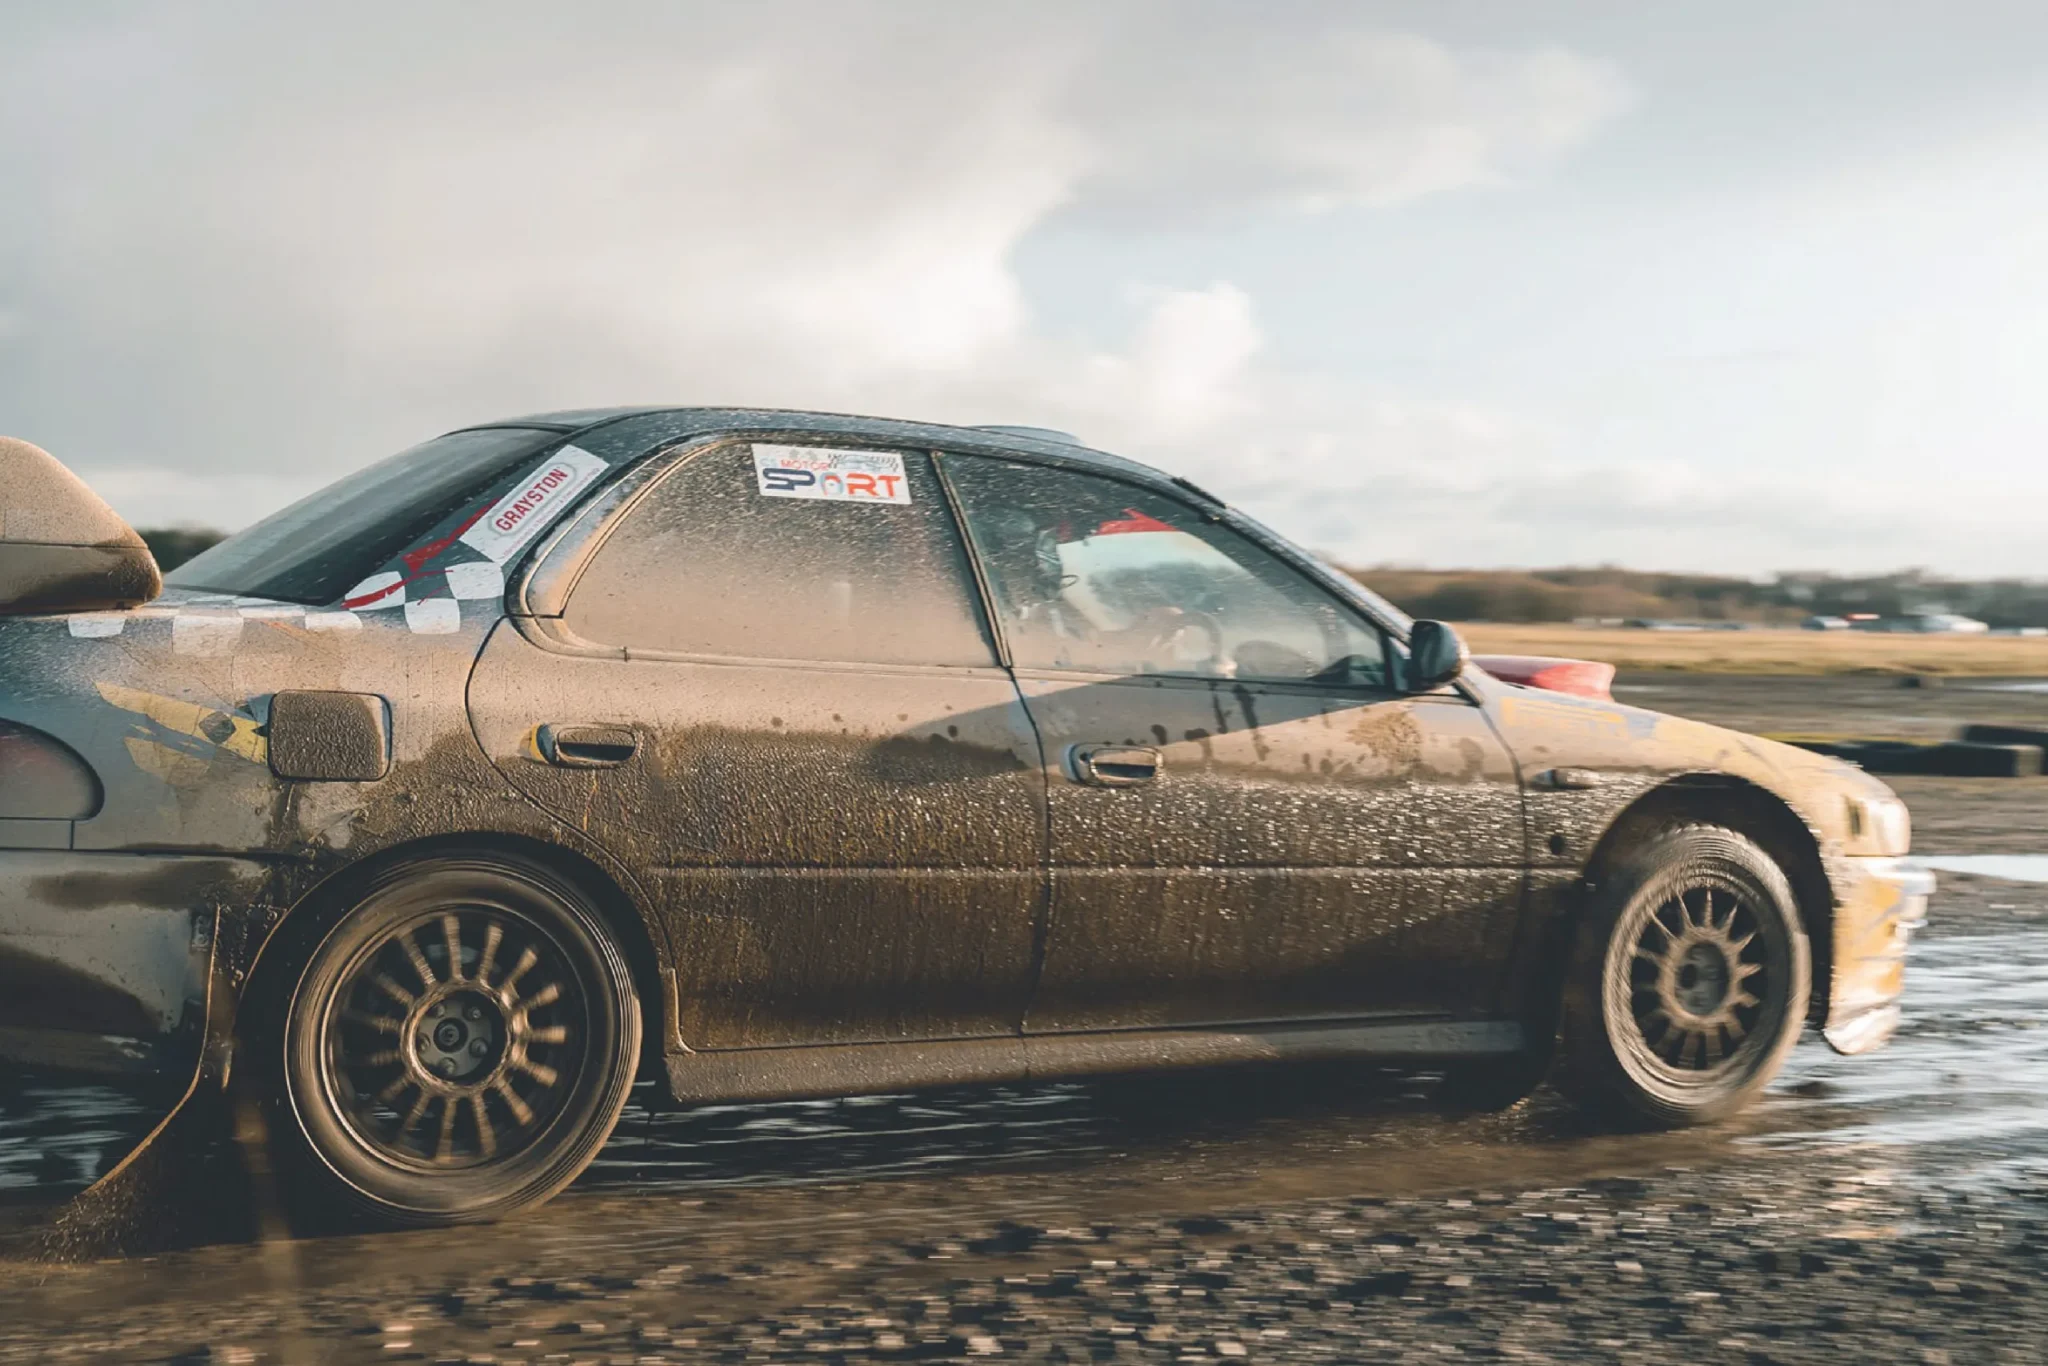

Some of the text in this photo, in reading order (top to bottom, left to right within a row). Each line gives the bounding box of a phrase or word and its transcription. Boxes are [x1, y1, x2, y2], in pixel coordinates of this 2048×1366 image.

[780, 459, 829, 471] MOTOR
[762, 467, 901, 498] SPORT
[495, 468, 568, 531] GRAYSTON
